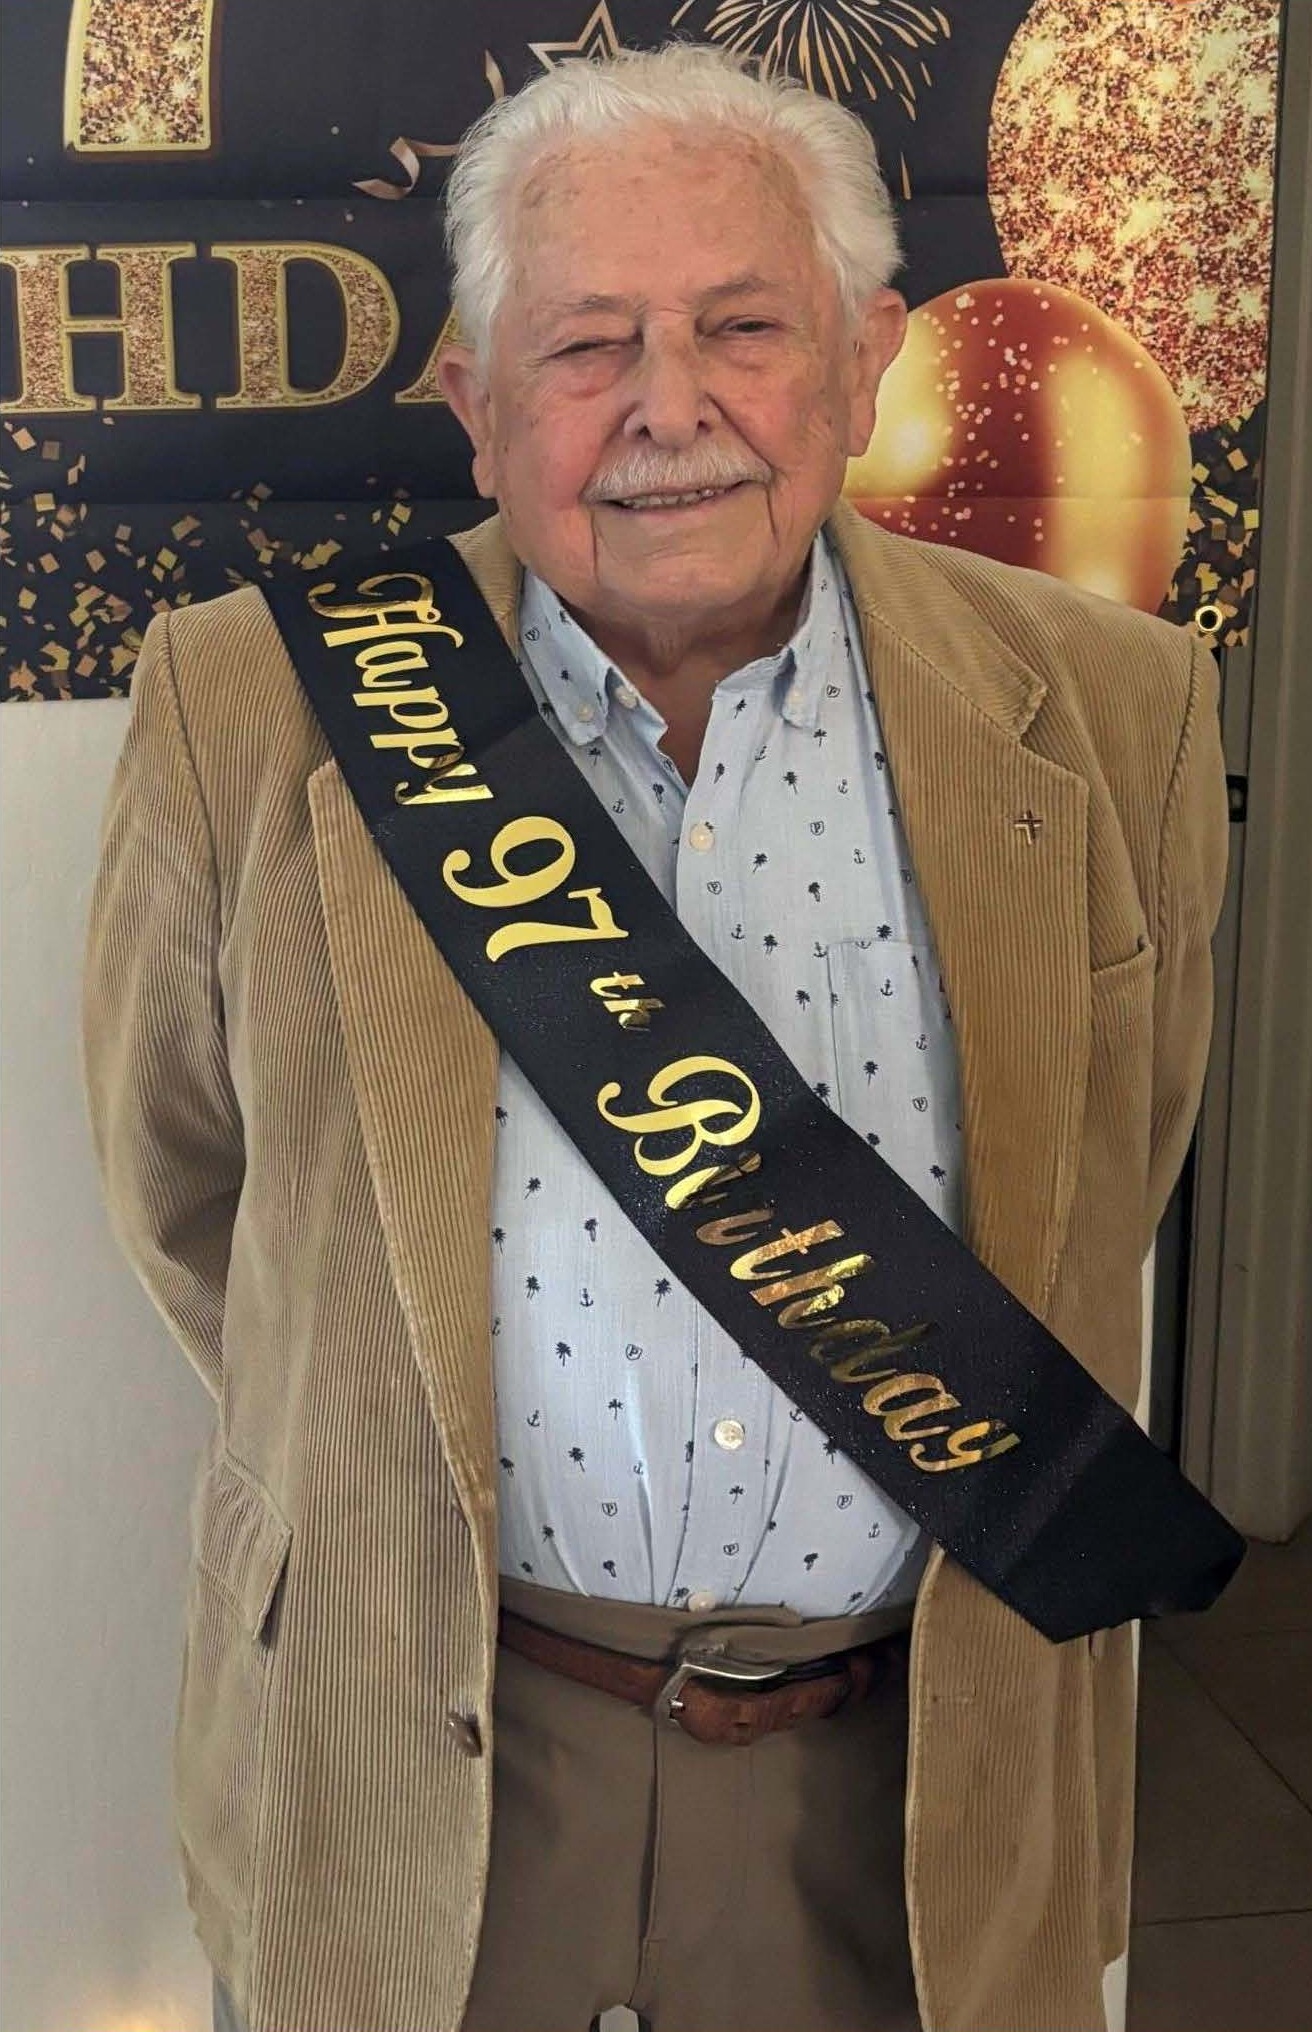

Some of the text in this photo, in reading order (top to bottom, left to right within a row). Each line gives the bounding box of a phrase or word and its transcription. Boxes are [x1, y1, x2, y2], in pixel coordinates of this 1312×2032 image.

[308, 572, 494, 805] Happy
[442, 815, 628, 962] 97
[597, 1055, 1021, 1473] Birthday
